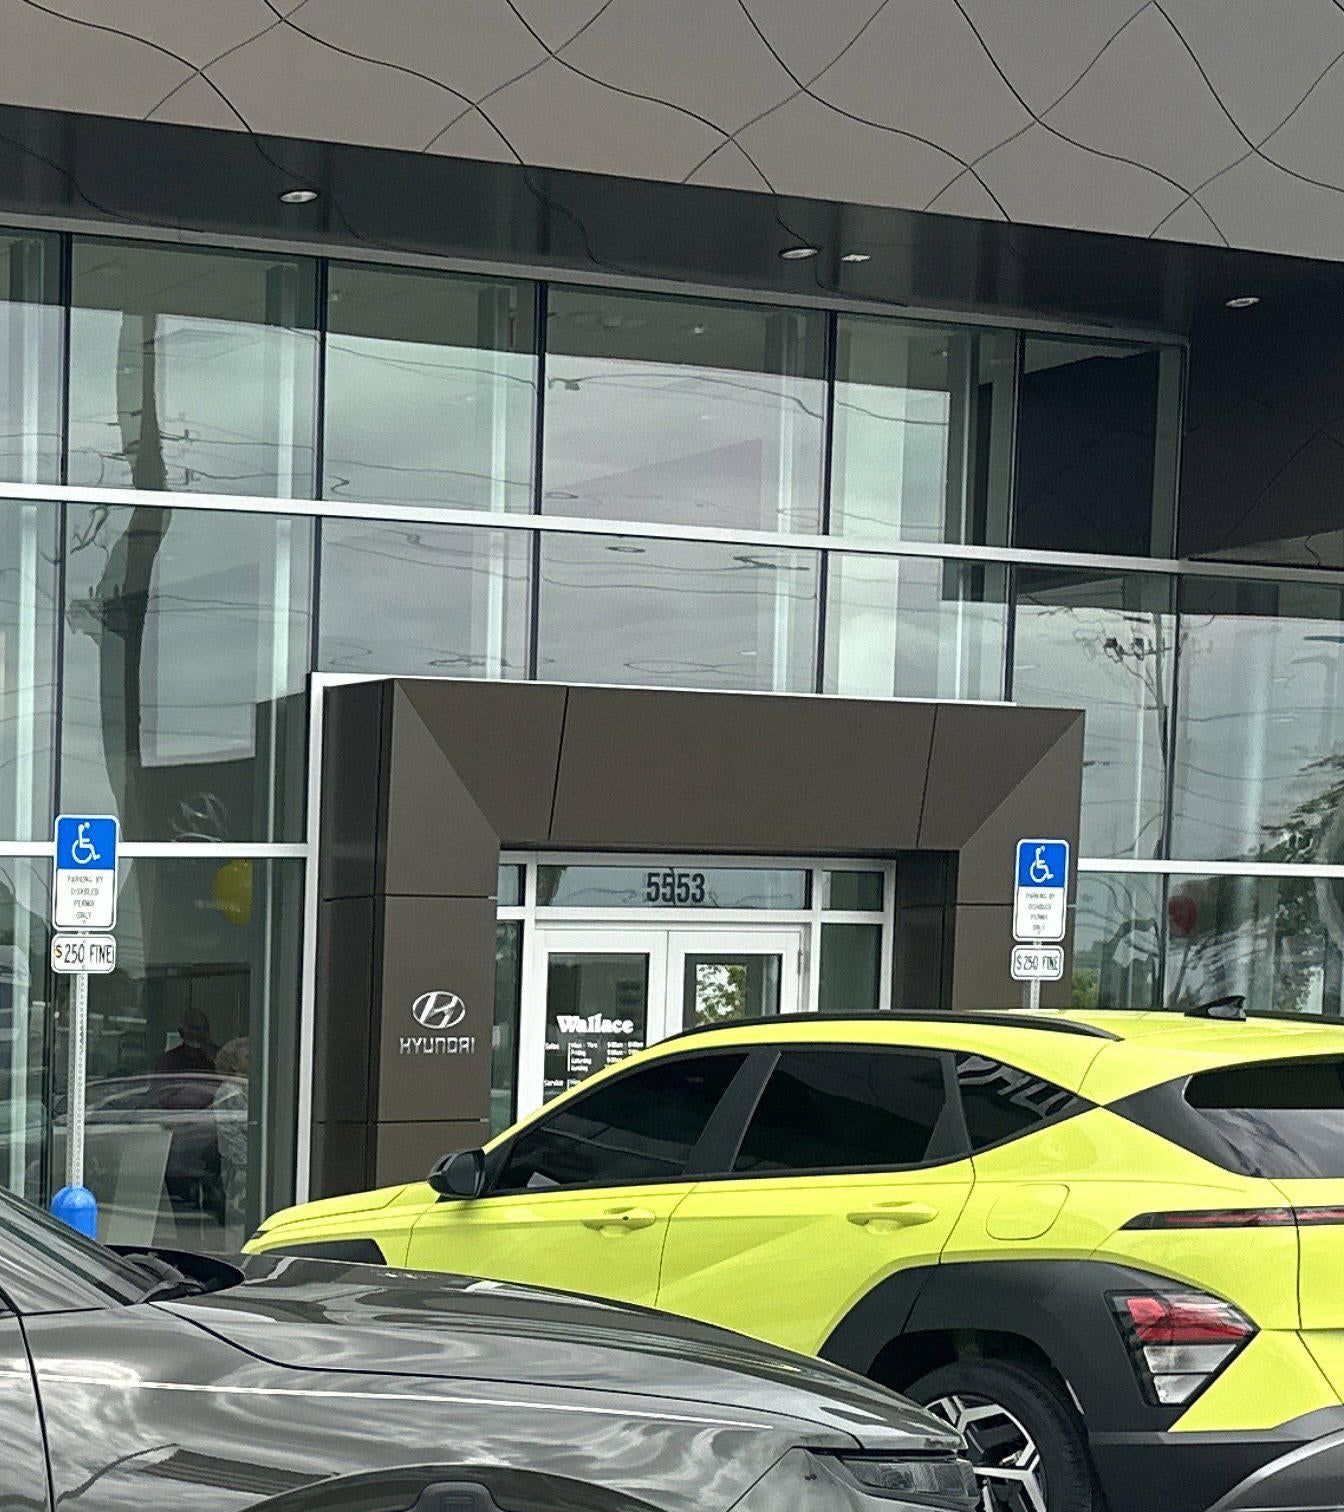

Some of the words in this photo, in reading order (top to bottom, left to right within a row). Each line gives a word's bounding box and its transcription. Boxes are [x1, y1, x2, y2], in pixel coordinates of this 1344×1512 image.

[647, 872, 706, 903] 5553
[89, 944, 113, 964] FINE
[556, 1012, 635, 1034] Wallace
[399, 1036, 475, 1055] HYUNDAI
